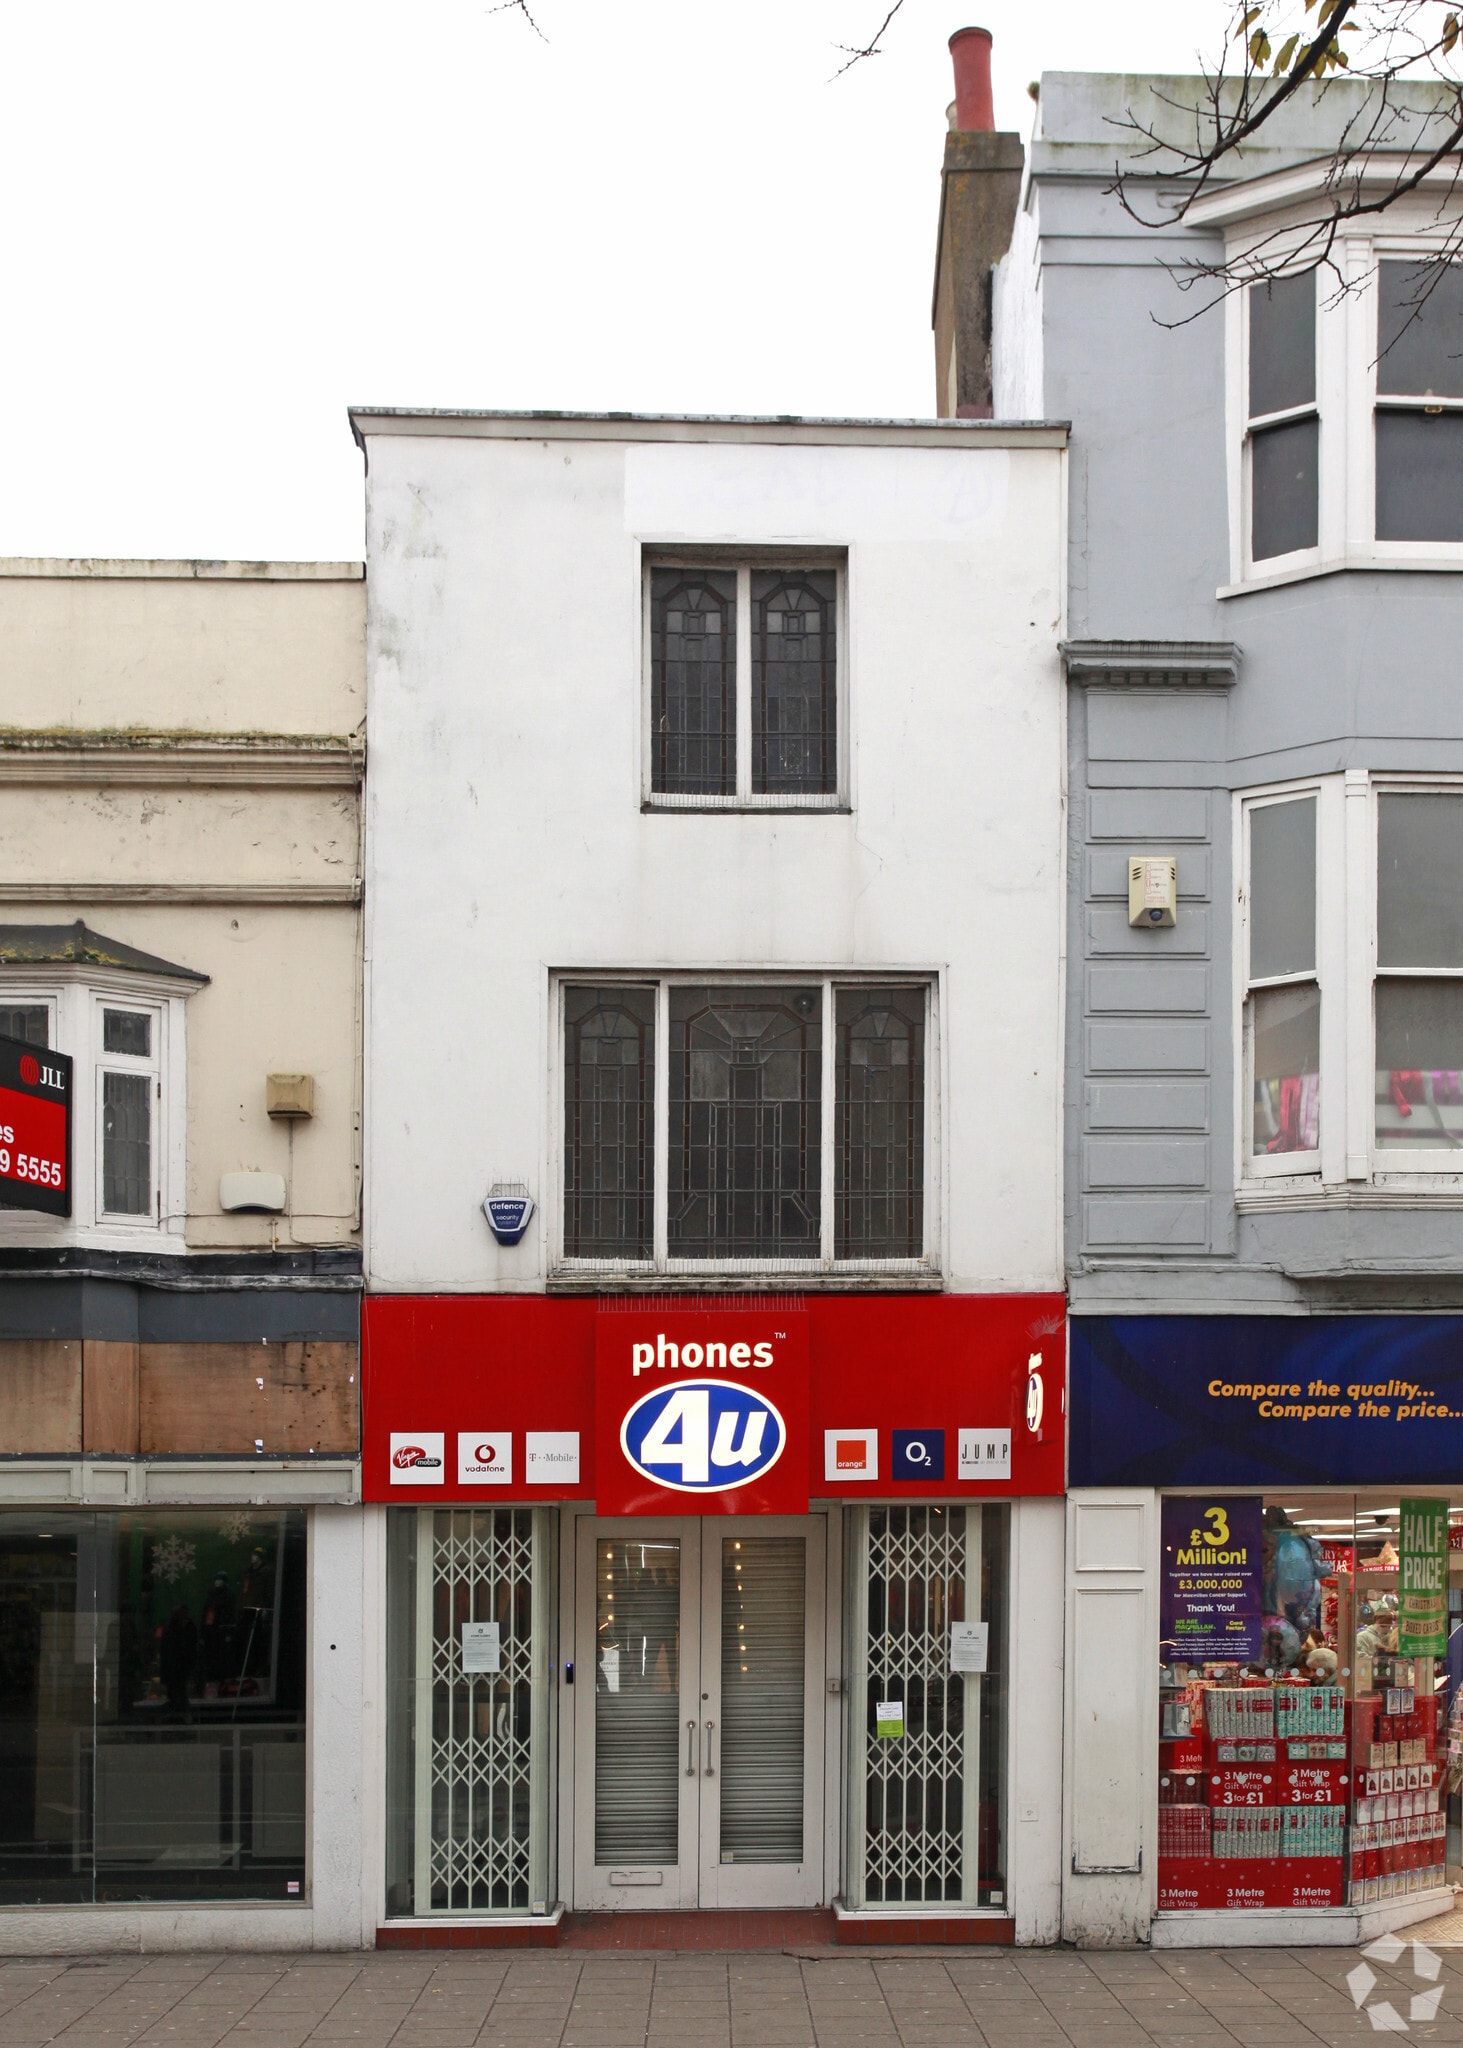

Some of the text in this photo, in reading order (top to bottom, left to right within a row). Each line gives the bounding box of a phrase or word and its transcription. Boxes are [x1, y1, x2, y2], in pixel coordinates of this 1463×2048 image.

[40, 1065, 65, 1090] JLL
[17, 1153, 62, 1186] 5555
[632, 1333, 774, 1377] phones
[1208, 1380, 1435, 1400] Compare the quality...
[1258, 1401, 1352, 1421] Compare
[1358, 1401, 1391, 1417] the
[640, 1390, 768, 1482] 4u
[962, 1444, 1008, 1459] JUMP
[838, 1461, 863, 1469] orange
[1404, 1515, 1442, 1552] HALF
[1176, 1548, 1247, 1565] Million!
[1404, 1557, 1442, 1589] PRICE
[1179, 1580, 1242, 1590] £3,000,000
[1187, 1604, 1235, 1612] Thank You!
[1225, 1771, 1262, 1780] 3 Metre
[1292, 1769, 1330, 1778] 3 Metre
[1225, 1782, 1239, 1790] Gift
[1224, 1792, 1263, 1803] 3 for £1
[1291, 1790, 1332, 1801] 3 for £1
[1160, 1888, 1198, 1897] 3 Metre
[1227, 1888, 1265, 1897] 3 Metre
[1293, 1887, 1331, 1896] 3 Metre
[1177, 1900, 1198, 1908] Wrap
[1244, 1900, 1265, 1908] Wrap
[1310, 1899, 1331, 1907] Wrap
